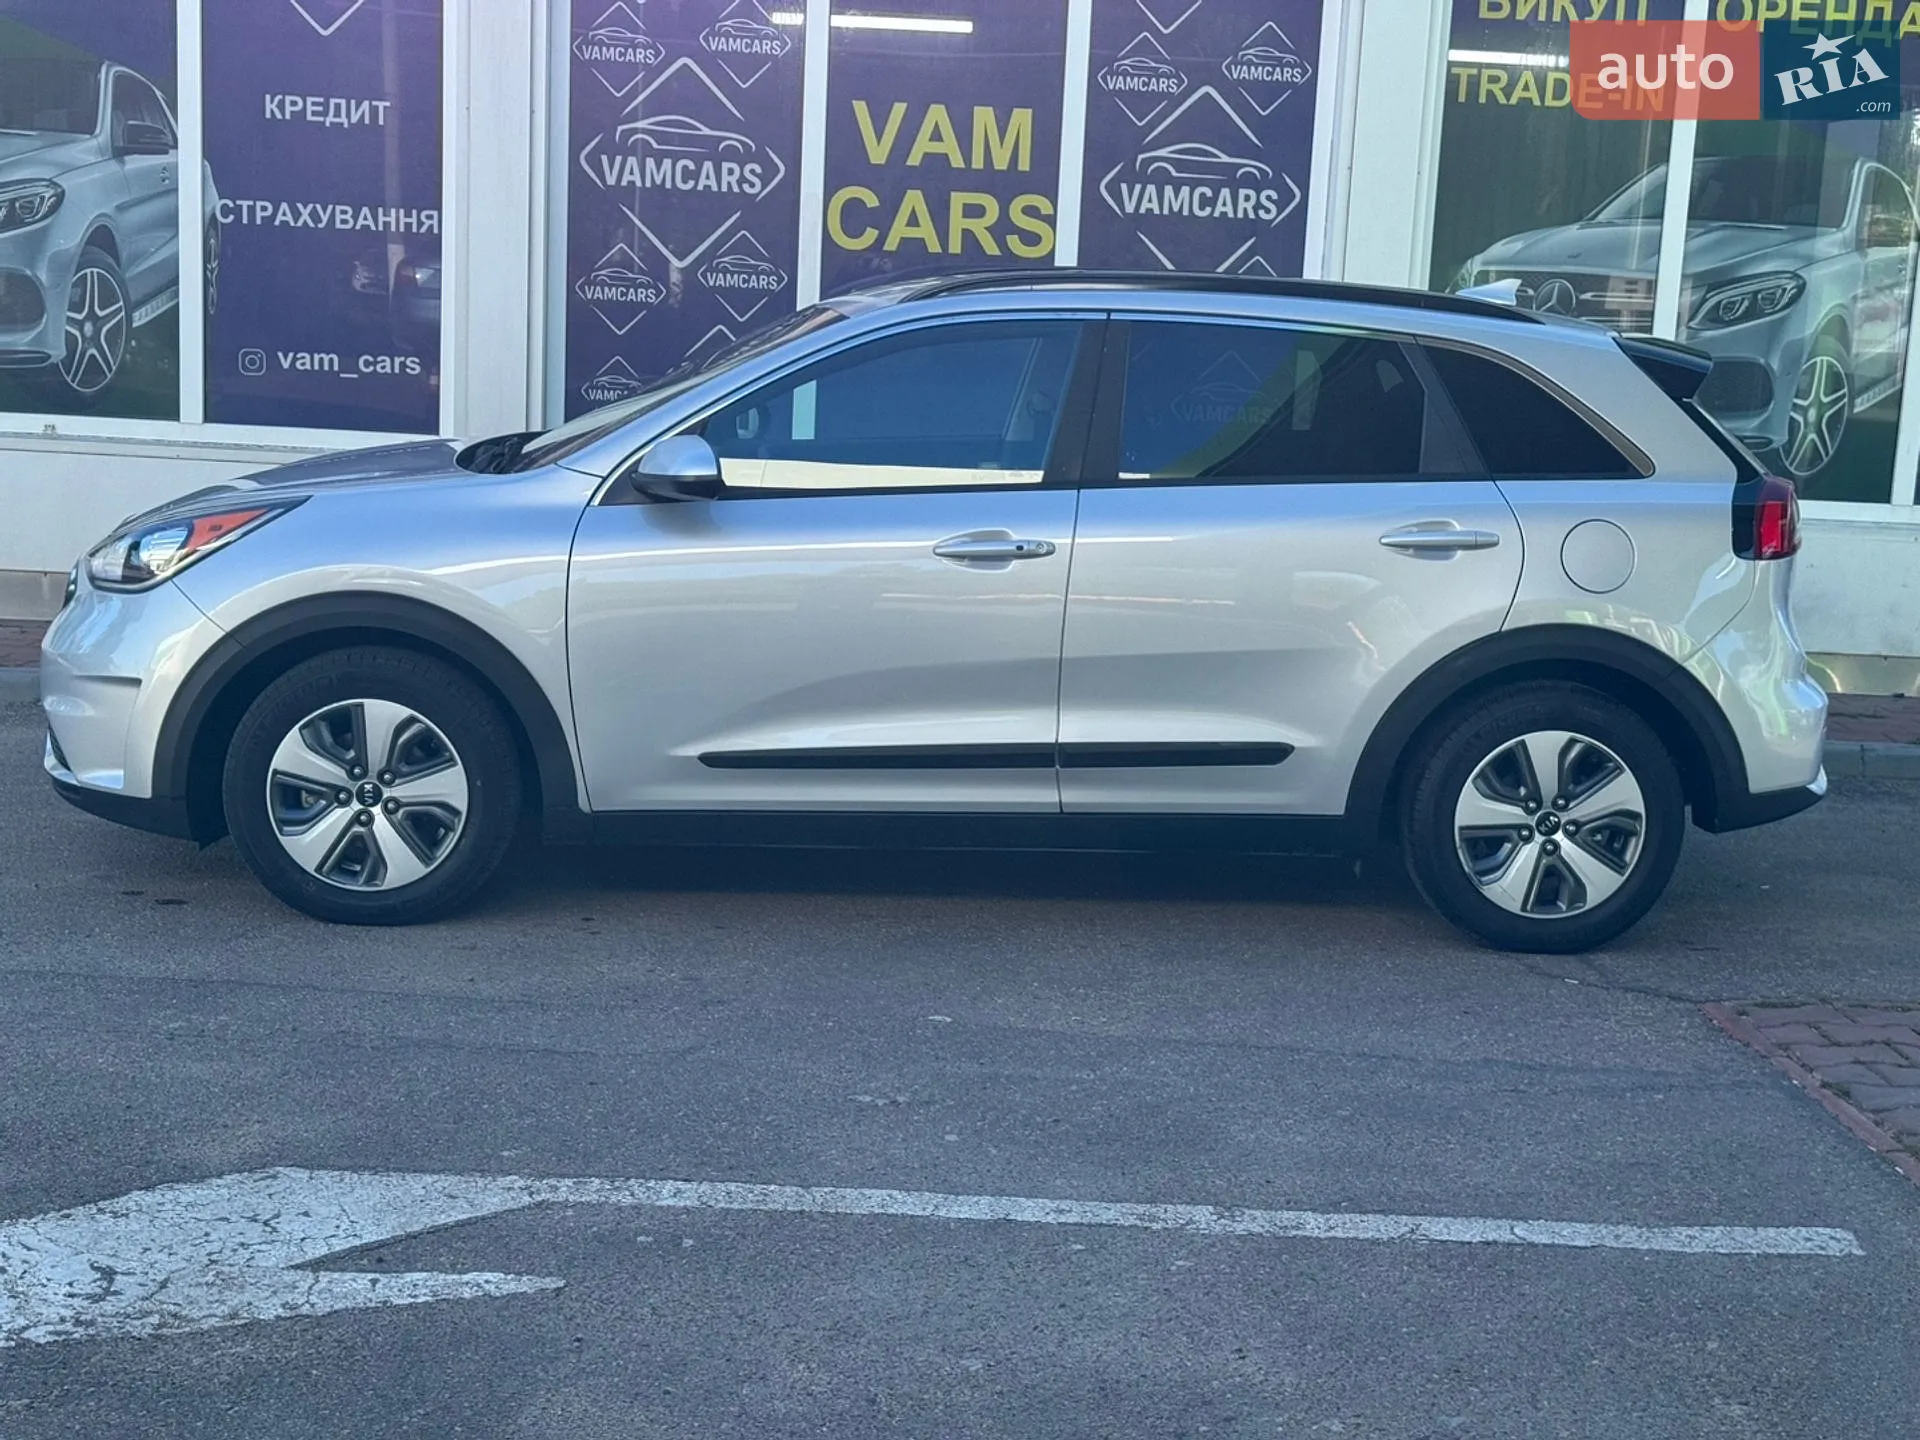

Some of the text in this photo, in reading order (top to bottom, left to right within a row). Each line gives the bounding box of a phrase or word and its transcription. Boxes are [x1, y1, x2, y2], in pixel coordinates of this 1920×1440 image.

[581, 44, 656, 65] VAMCARS
[708, 36, 781, 56] VAMCARS
[1106, 74, 1178, 94] VAMCARS
[1229, 64, 1303, 84] VAMCARS
[1449, 67, 1664, 113] TRADE-IN
[264, 94, 391, 128] КРЕДИТ
[852, 99, 1033, 172] VAM
[600, 154, 763, 195] VAMCARS
[1120, 182, 1280, 220] VAMCARS
[215, 197, 440, 235] СТРАХУВАННЯ
[826, 185, 1056, 259] CARS
[705, 271, 779, 291] VAMCARS
[584, 284, 657, 304] VAMCARS
[278, 350, 421, 378] vam_cars
[364, 784, 374, 805] KIA
[1539, 816, 1558, 833] KIA
